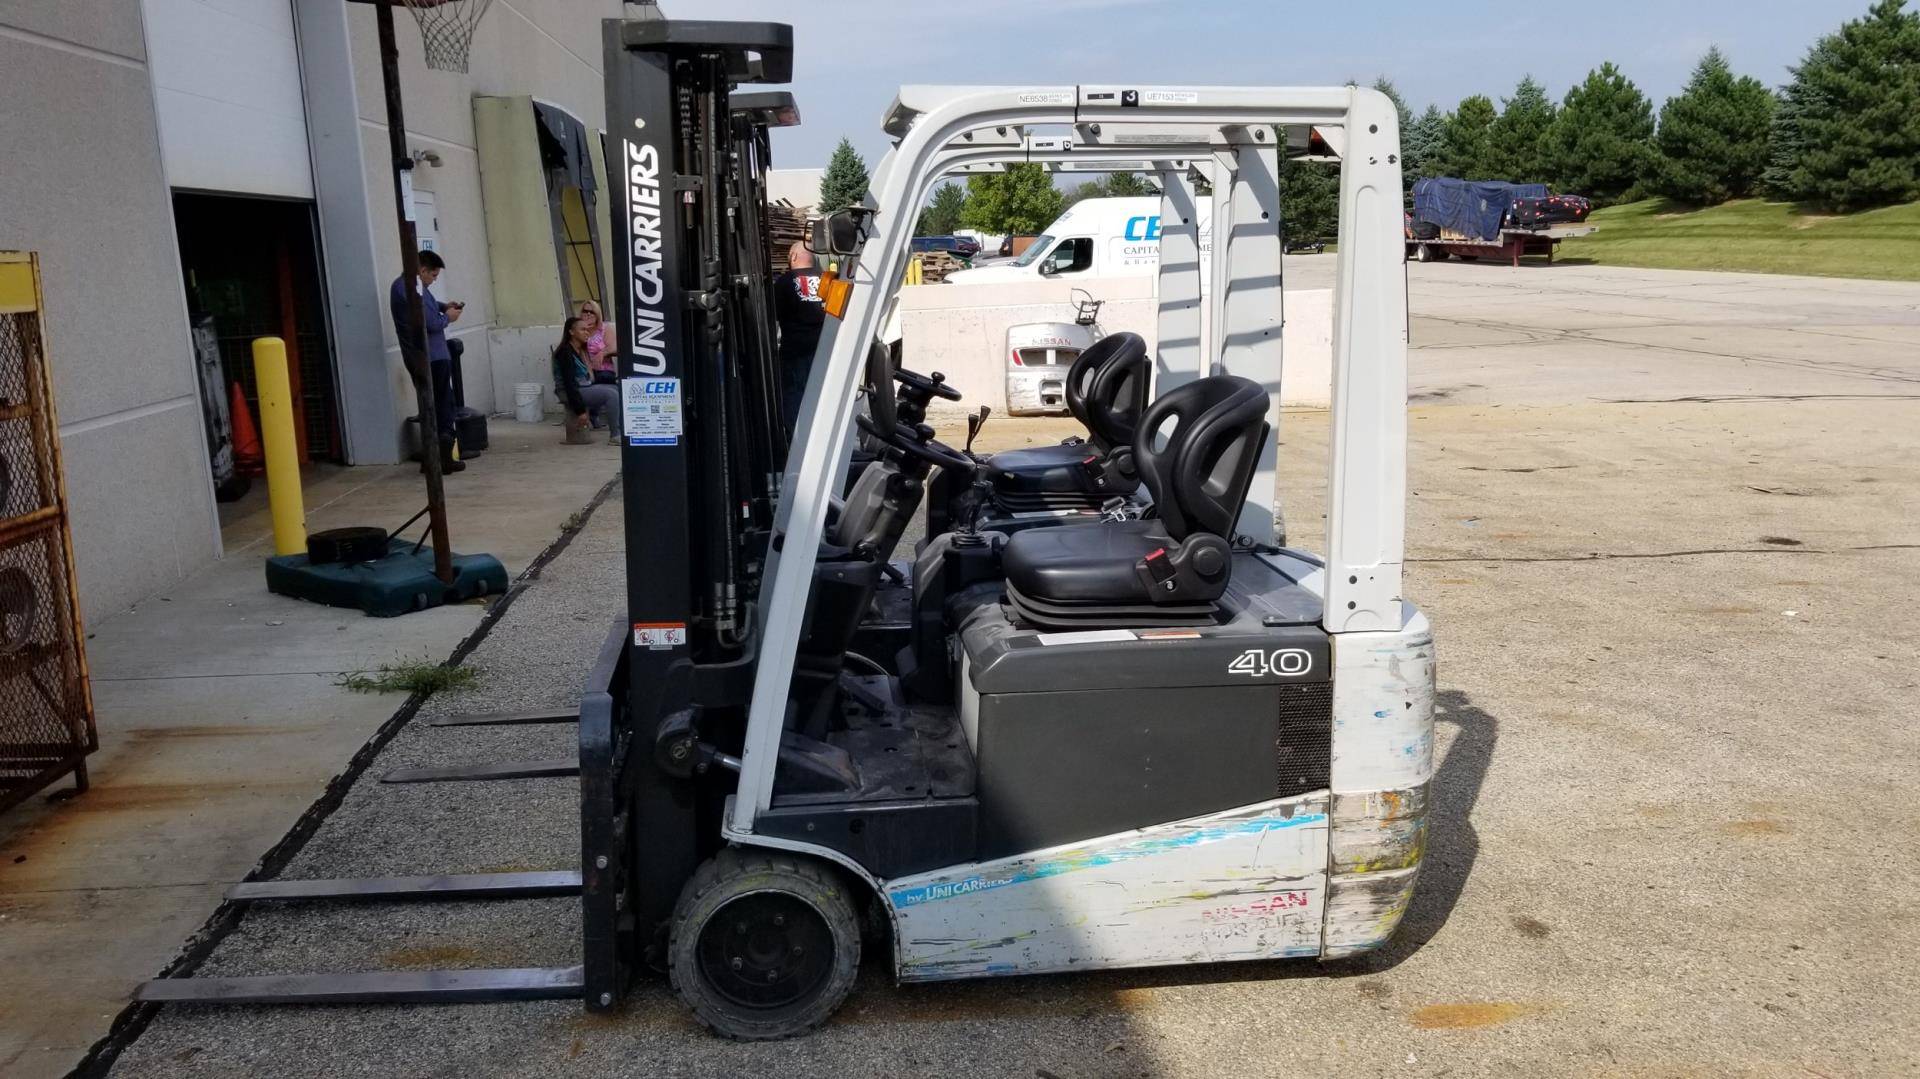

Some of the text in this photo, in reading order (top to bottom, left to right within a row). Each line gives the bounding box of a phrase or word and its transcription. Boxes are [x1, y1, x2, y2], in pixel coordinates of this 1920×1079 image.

[1126, 91, 1136, 102] 3
[1125, 216, 1161, 241] CE
[1123, 246, 1160, 255] CAPITA
[625, 140, 667, 376] UNICARRIERS
[1032, 337, 1071, 346] NISSAN
[645, 382, 676, 394] CEH
[1228, 648, 1312, 677] 40
